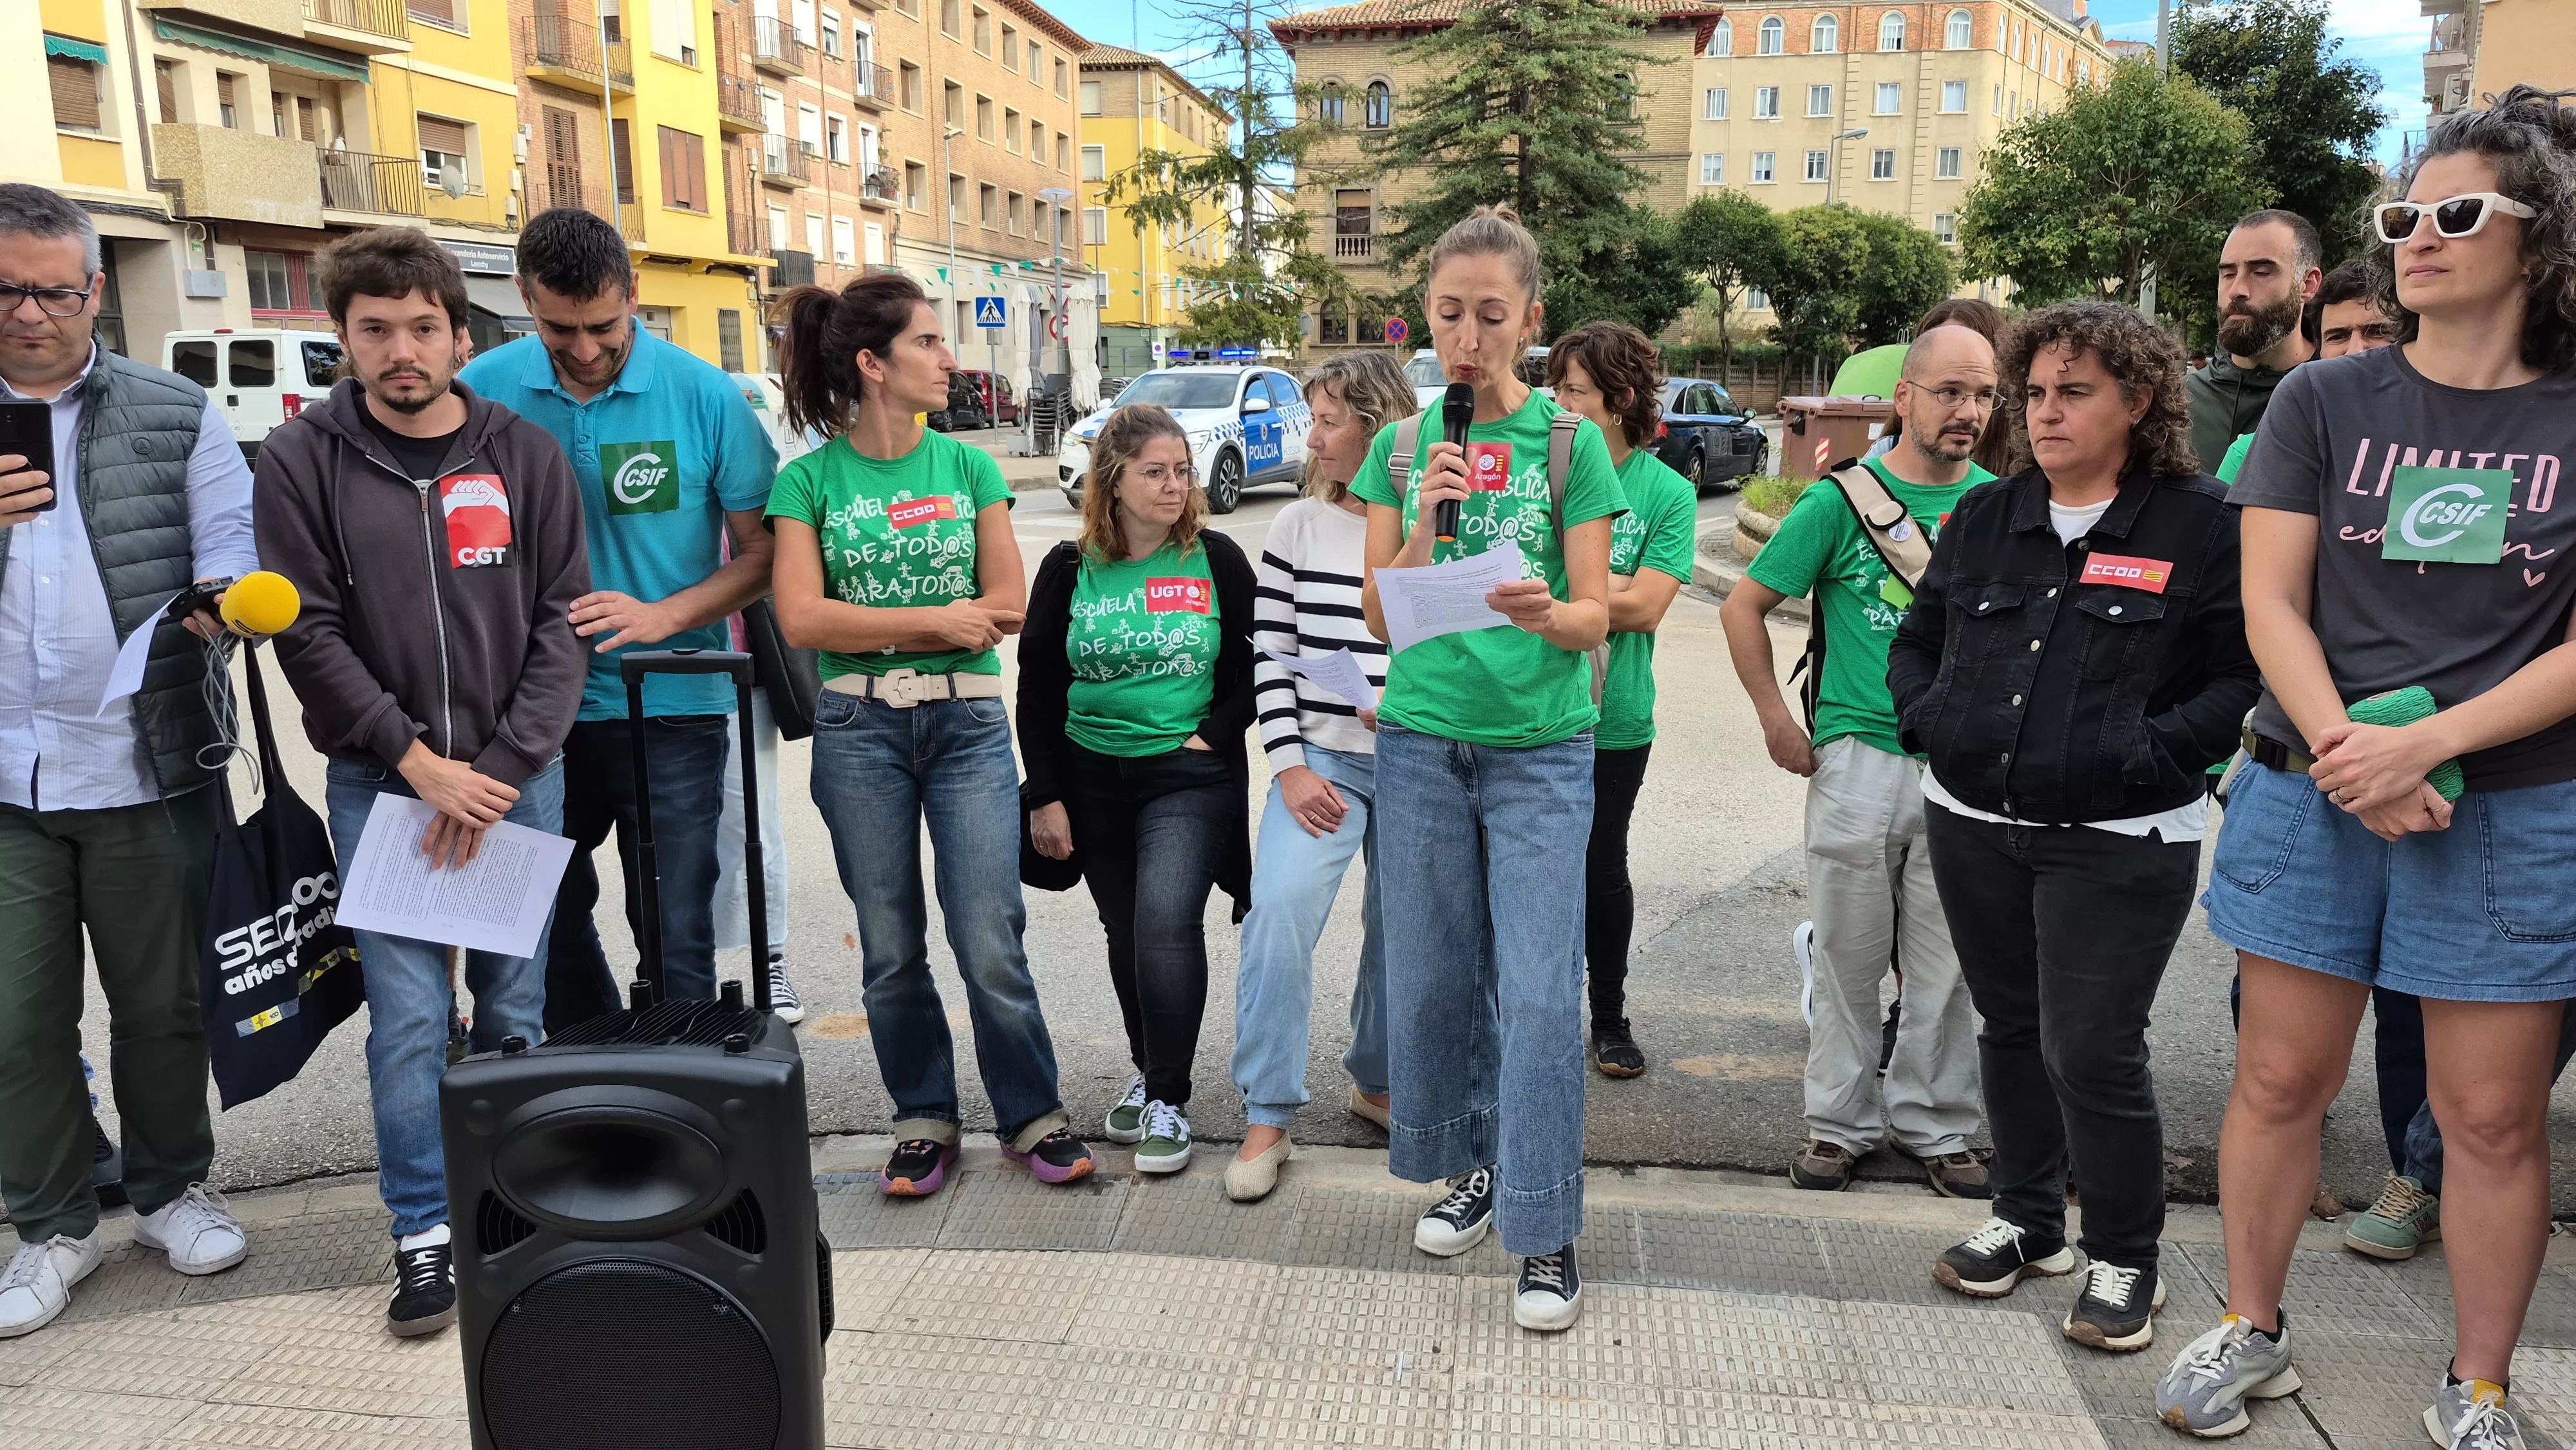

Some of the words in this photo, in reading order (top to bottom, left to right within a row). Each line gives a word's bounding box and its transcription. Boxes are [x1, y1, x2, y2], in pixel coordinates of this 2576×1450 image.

[477, 250, 509, 261] Autoservicio
[624, 467, 669, 487] CSIF
[1474, 473, 1502, 482] Aragón
[892, 504, 936, 521] CCOO
[2419, 501, 2493, 525] CSIF
[458, 547, 506, 565] CGT
[843, 542, 878, 568] DE
[890, 535, 972, 560] TOD@S
[2088, 563, 2142, 578] CCOO
[842, 578, 902, 604] PARA
[908, 575, 976, 597] TOD@S
[1151, 585, 1184, 598] UGT
[1072, 592, 1137, 618] ESCUELA
[1079, 637, 1106, 657] DE
[1120, 628, 1201, 649] TOD@S
[1138, 661, 1208, 677] TOD@S
[224, 958, 287, 995] años
[286, 944, 298, 968] d
[295, 906, 336, 947] radi
